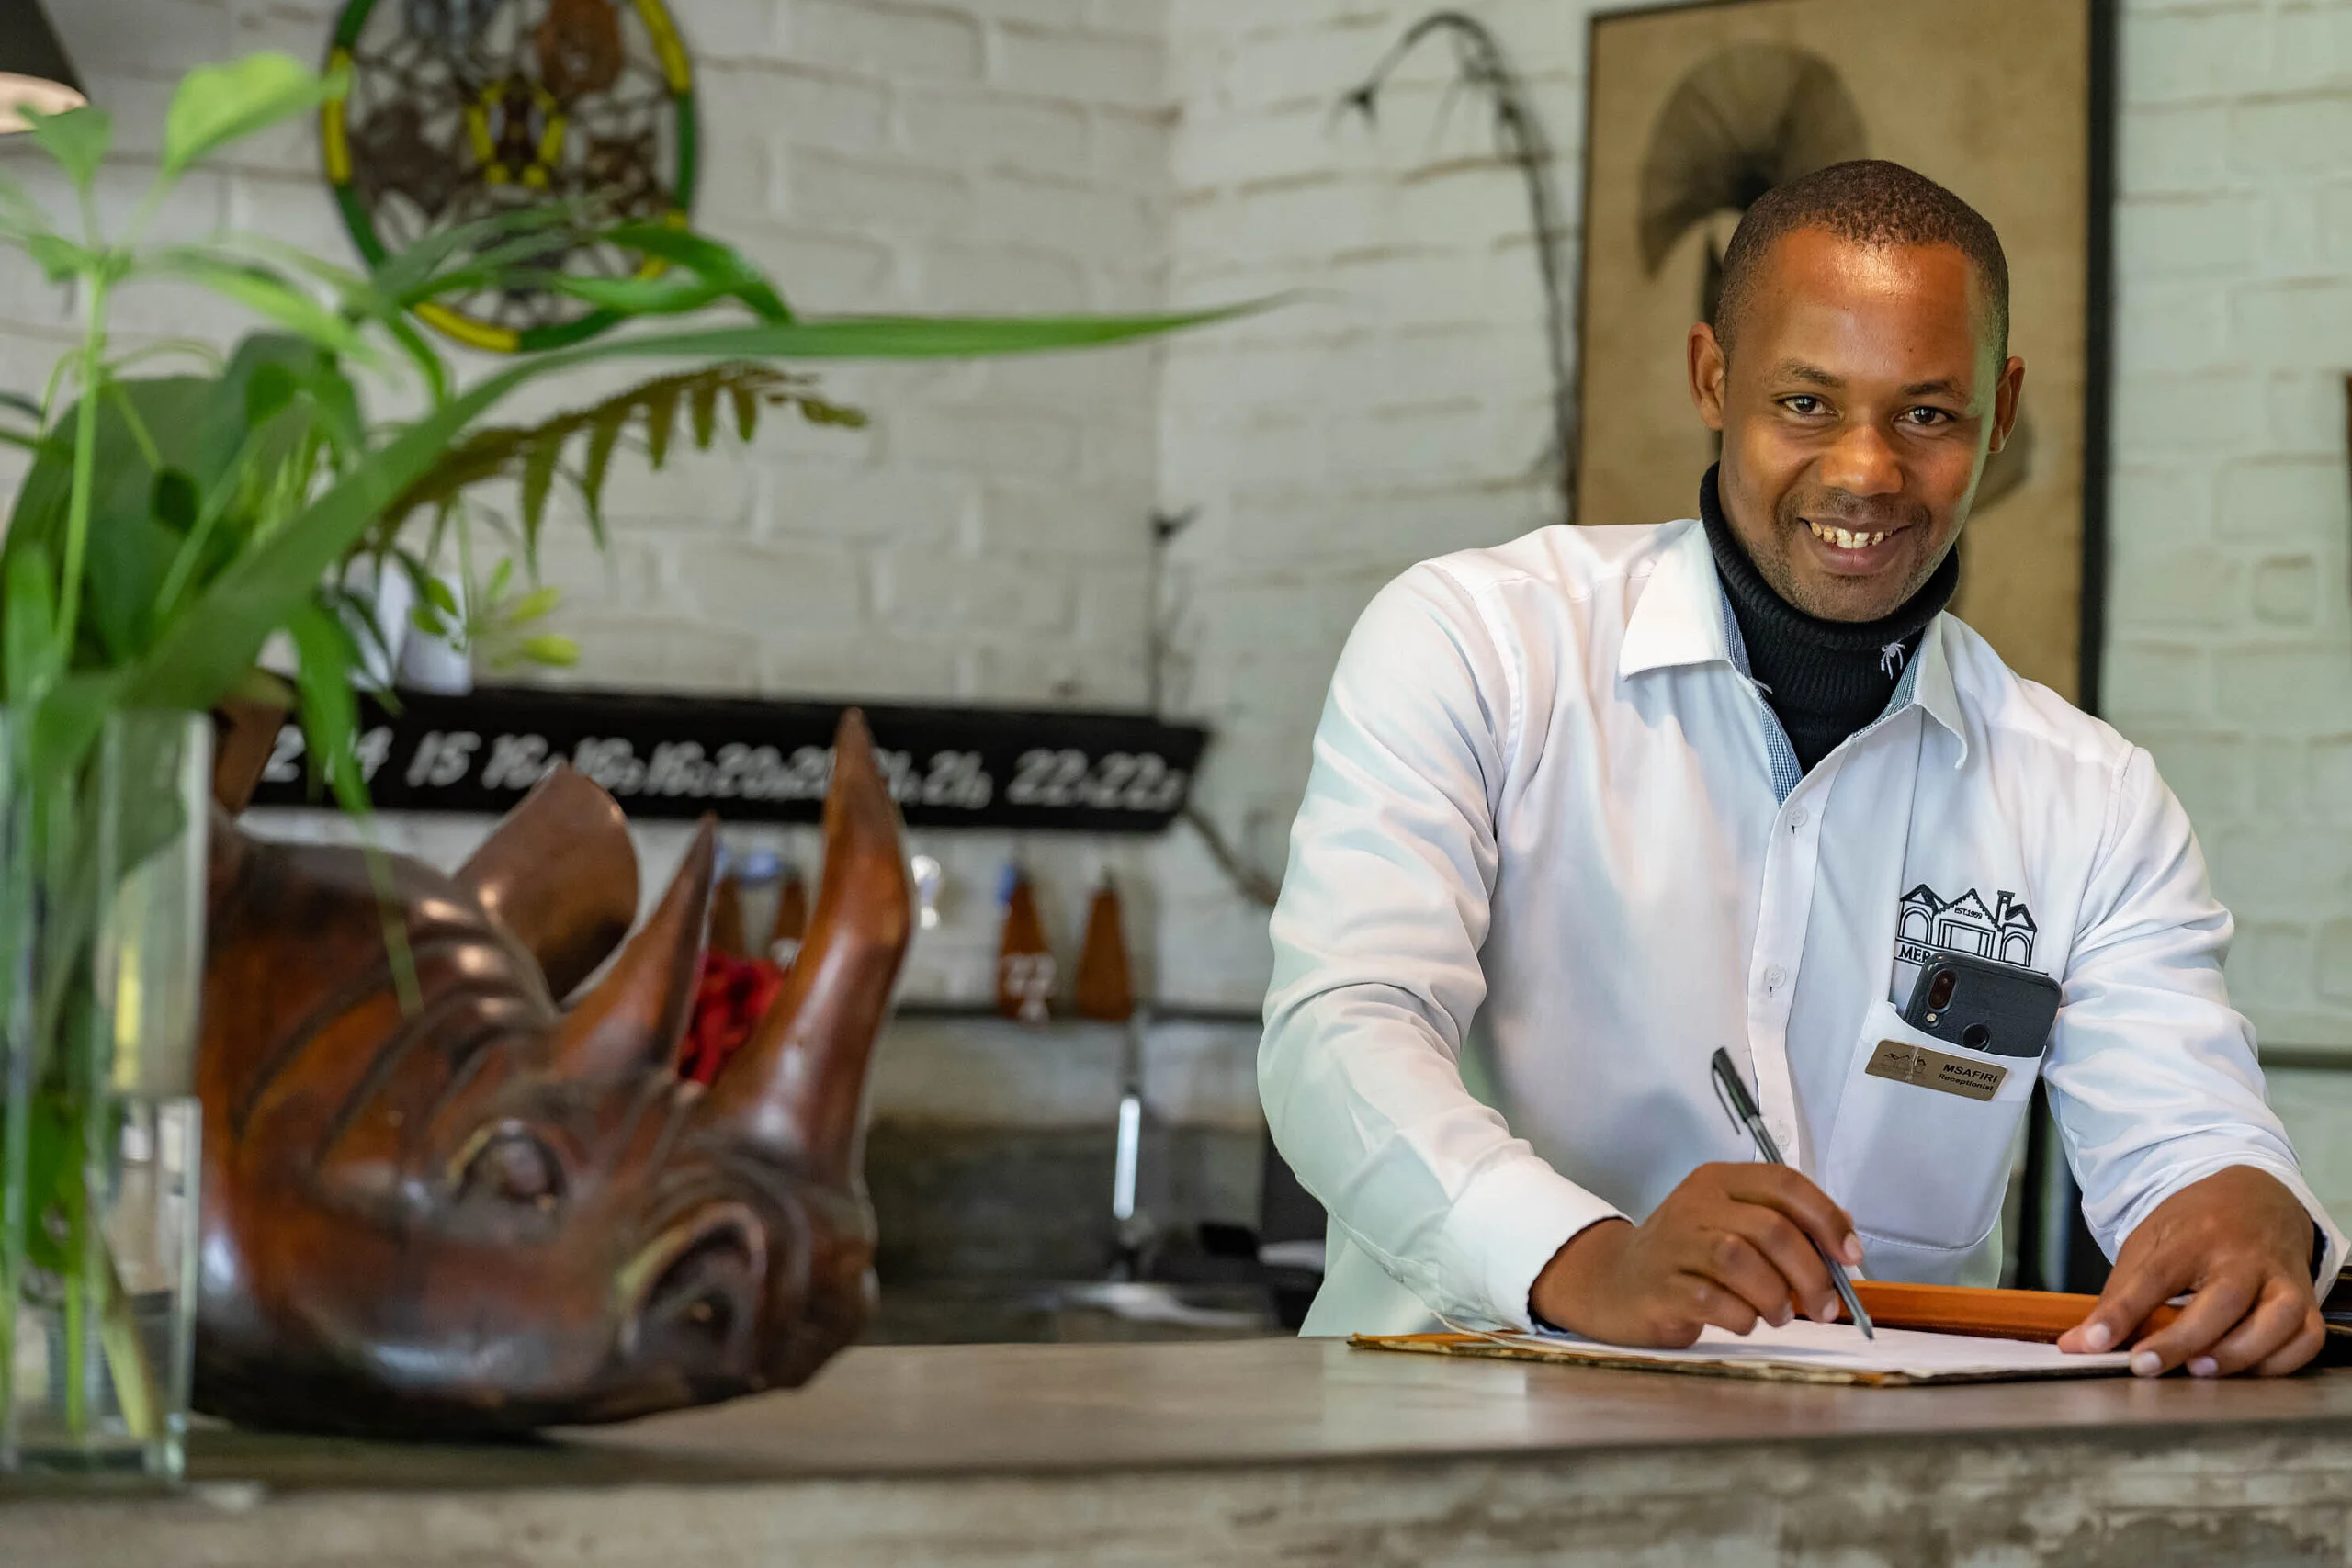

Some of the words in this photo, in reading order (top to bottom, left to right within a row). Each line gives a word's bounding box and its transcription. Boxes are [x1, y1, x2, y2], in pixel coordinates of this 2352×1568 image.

[405, 731, 481, 789] 15
[1938, 1073, 1994, 1091] Receptionist
[1942, 1064, 1998, 1083] MSAFIRI
